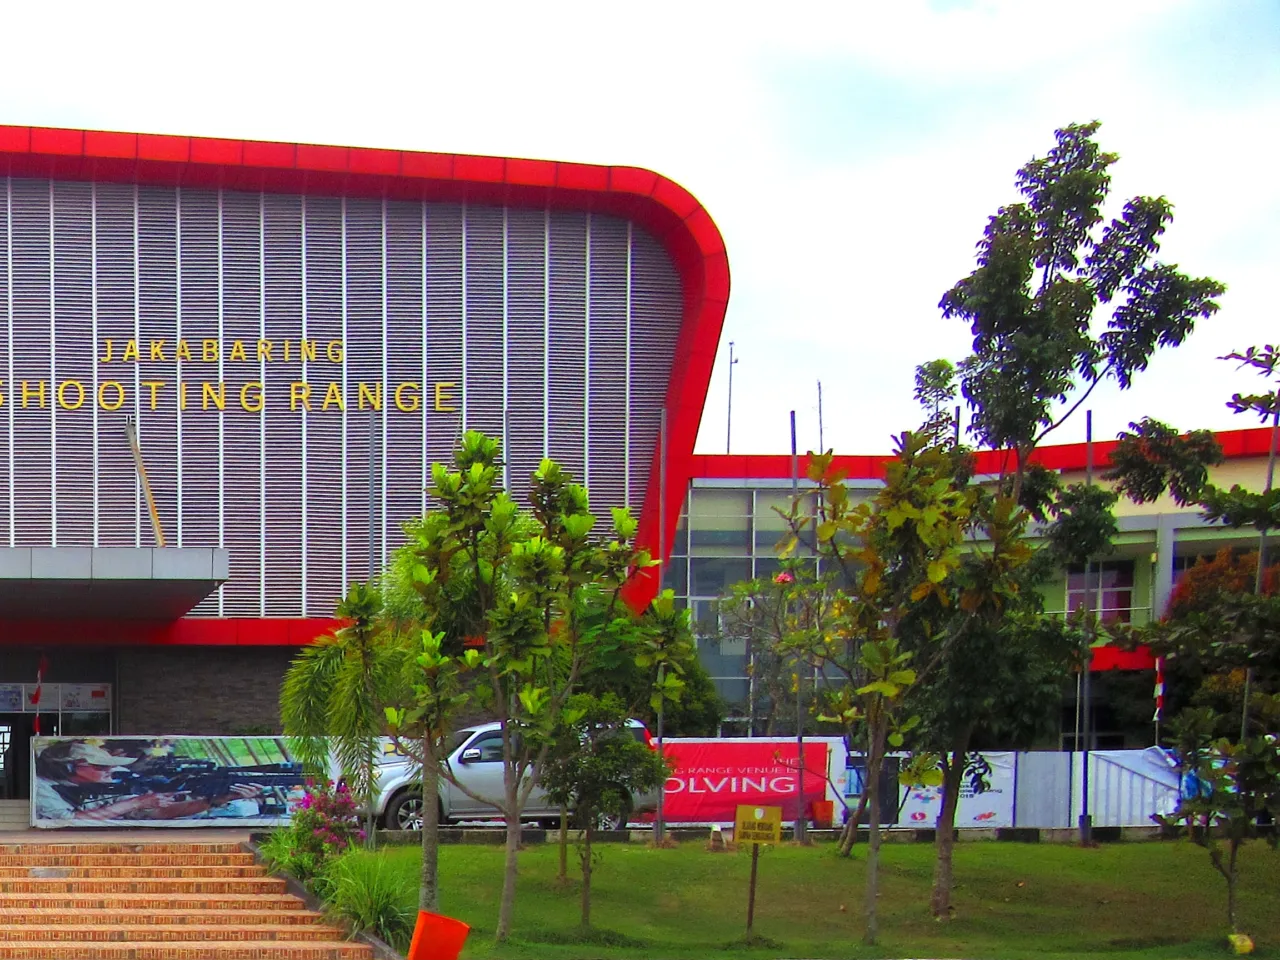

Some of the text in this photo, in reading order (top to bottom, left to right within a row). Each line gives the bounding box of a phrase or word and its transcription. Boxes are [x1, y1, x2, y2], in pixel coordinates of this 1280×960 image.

[101, 339, 344, 363] JAKABARING
[289, 382, 457, 412] RANGE
[687, 766, 734, 775] RANGE
[737, 766, 778, 774] VENUE
[663, 776, 796, 793] OLVING
